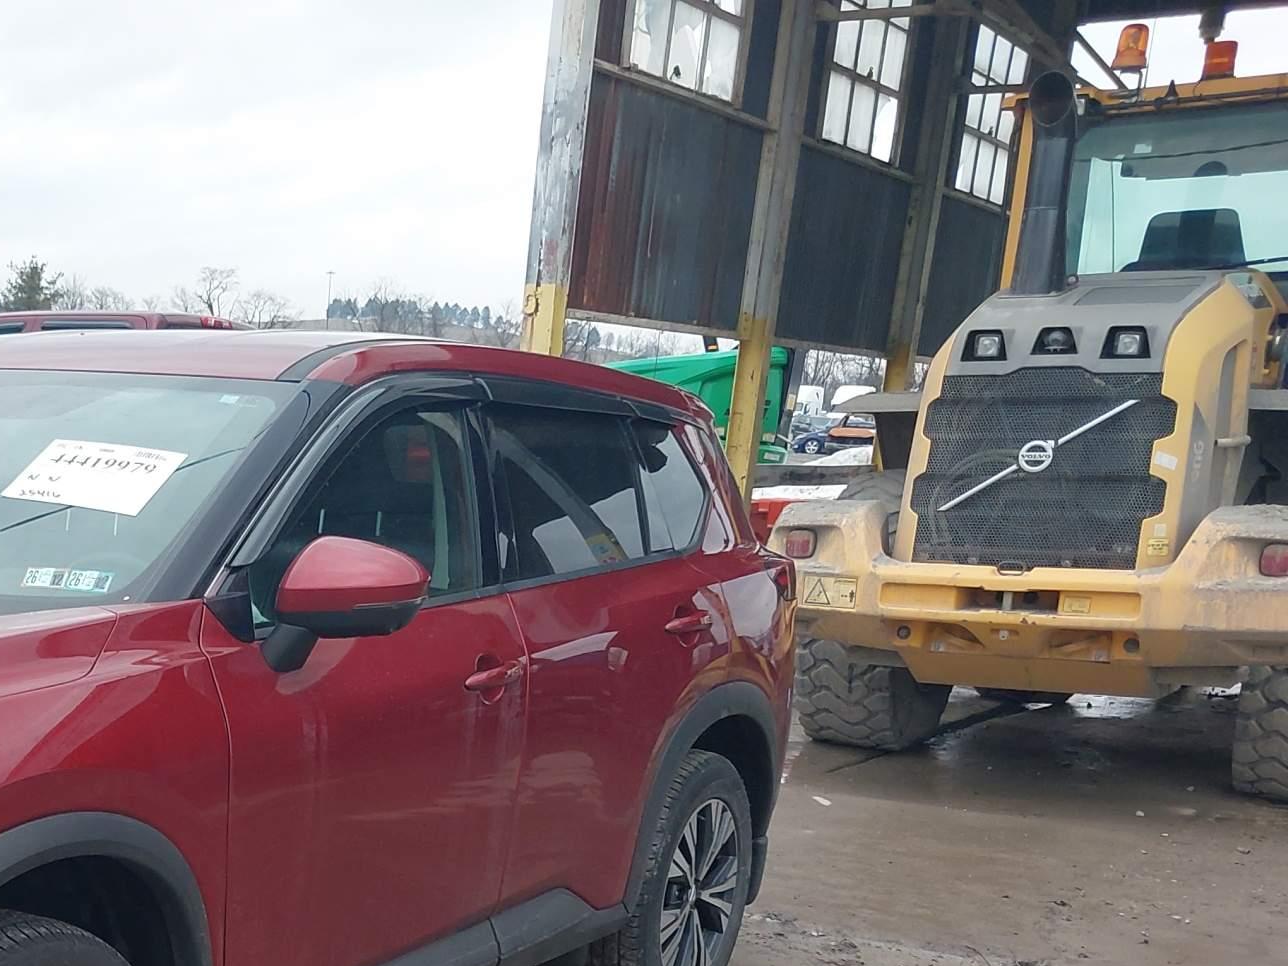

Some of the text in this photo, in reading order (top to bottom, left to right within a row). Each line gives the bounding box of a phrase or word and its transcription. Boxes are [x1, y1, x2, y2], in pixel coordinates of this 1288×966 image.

[50, 453, 157, 473] 44419979
[25, 570, 39, 584] 26
[68, 572, 83, 587] 26
